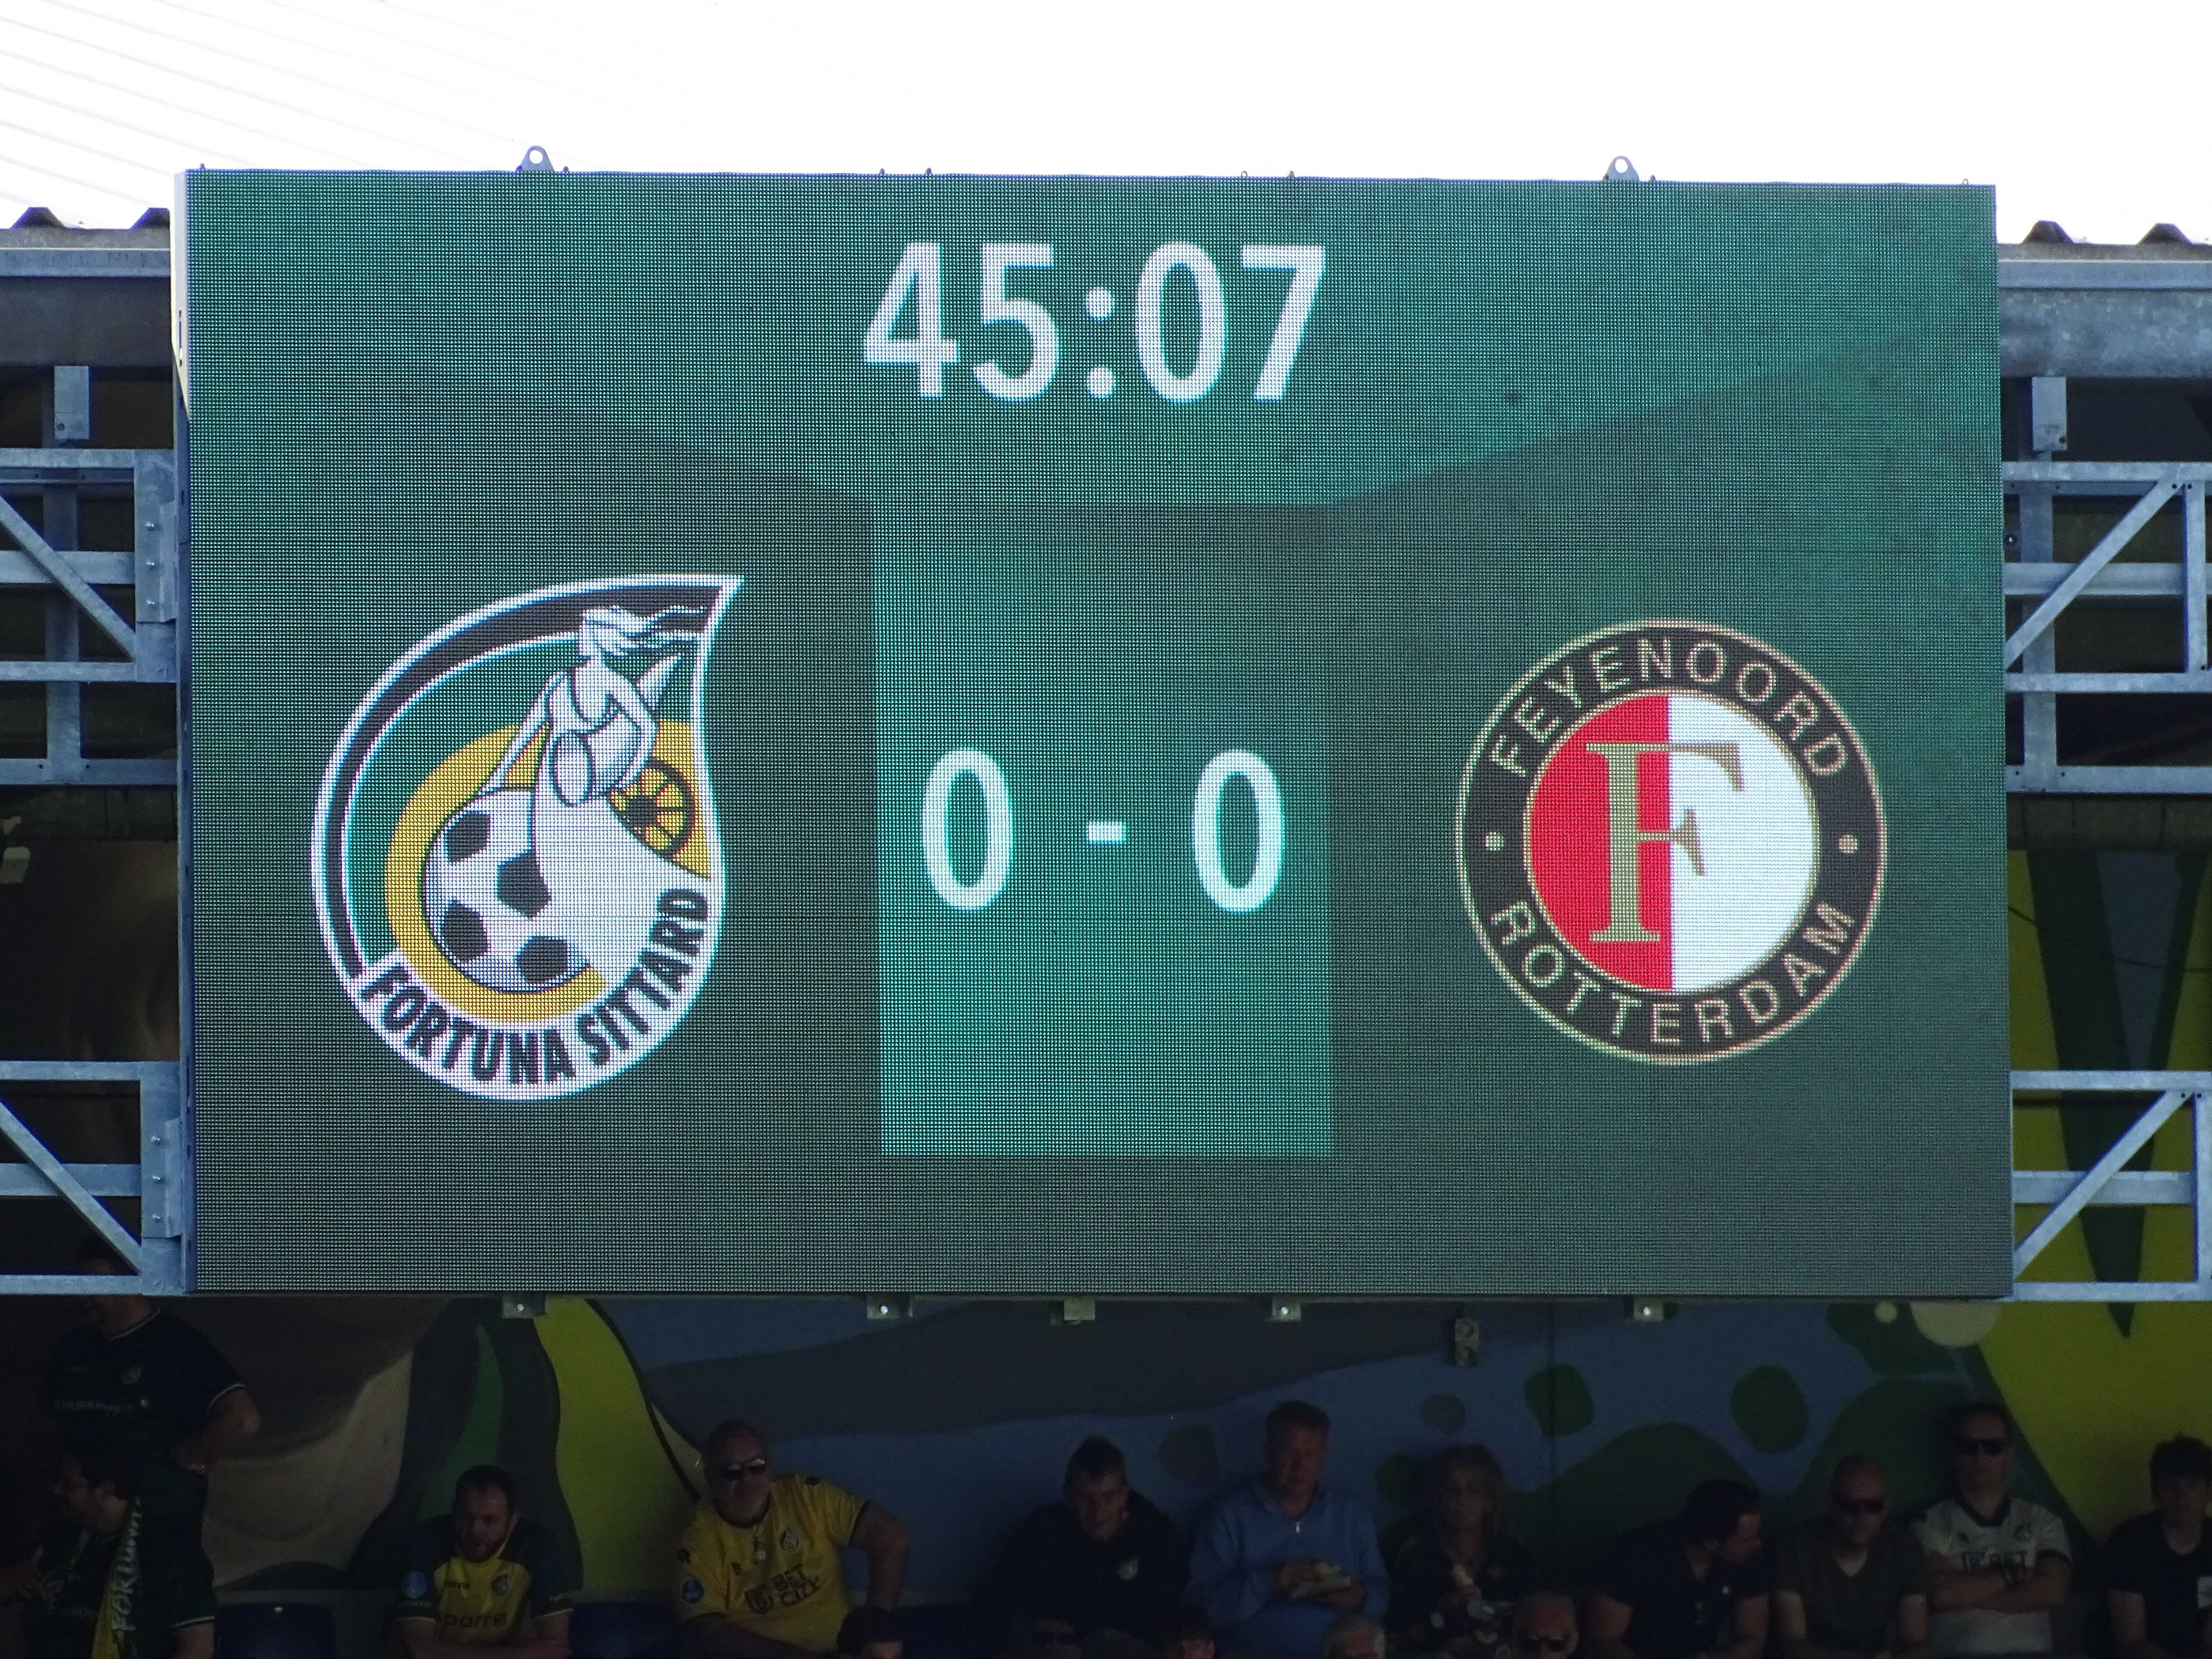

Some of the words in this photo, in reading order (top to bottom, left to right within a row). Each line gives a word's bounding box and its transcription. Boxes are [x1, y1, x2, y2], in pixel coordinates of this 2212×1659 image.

[862, 240, 1327, 404] 45:07
[1490, 637, 1849, 777] FEYENOORD
[923, 748, 1014, 911] 0
[1086, 821, 1128, 844] -
[1193, 749, 1285, 913] 0
[1586, 742, 1745, 942] F
[360, 966, 576, 1085] FORTUNA
[576, 888, 708, 1066] SITTARD
[1490, 901, 1855, 1045] ROTTERDAM
